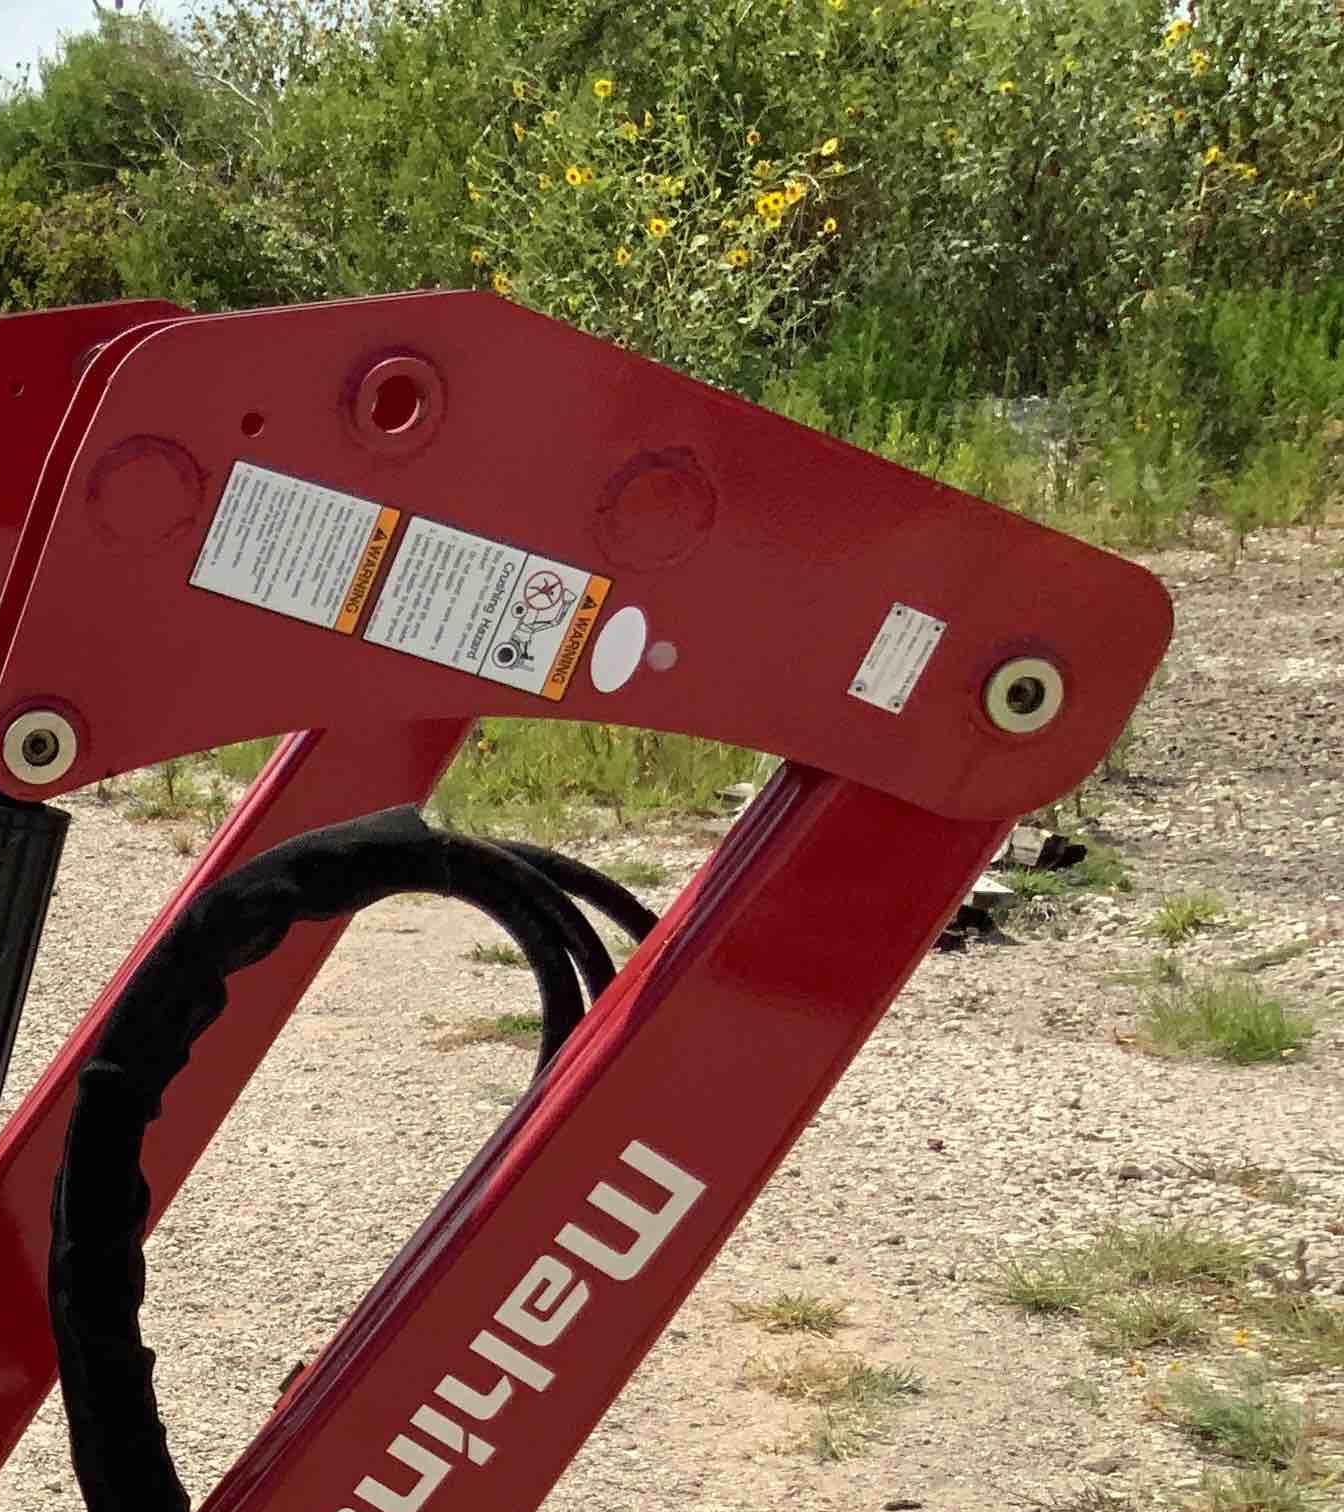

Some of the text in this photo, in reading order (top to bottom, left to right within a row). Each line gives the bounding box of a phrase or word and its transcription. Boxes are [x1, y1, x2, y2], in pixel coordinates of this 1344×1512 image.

[344, 543, 383, 616] WARNING
[465, 559, 517, 661] Crushing Hazard
[550, 614, 591, 686] WARNING
